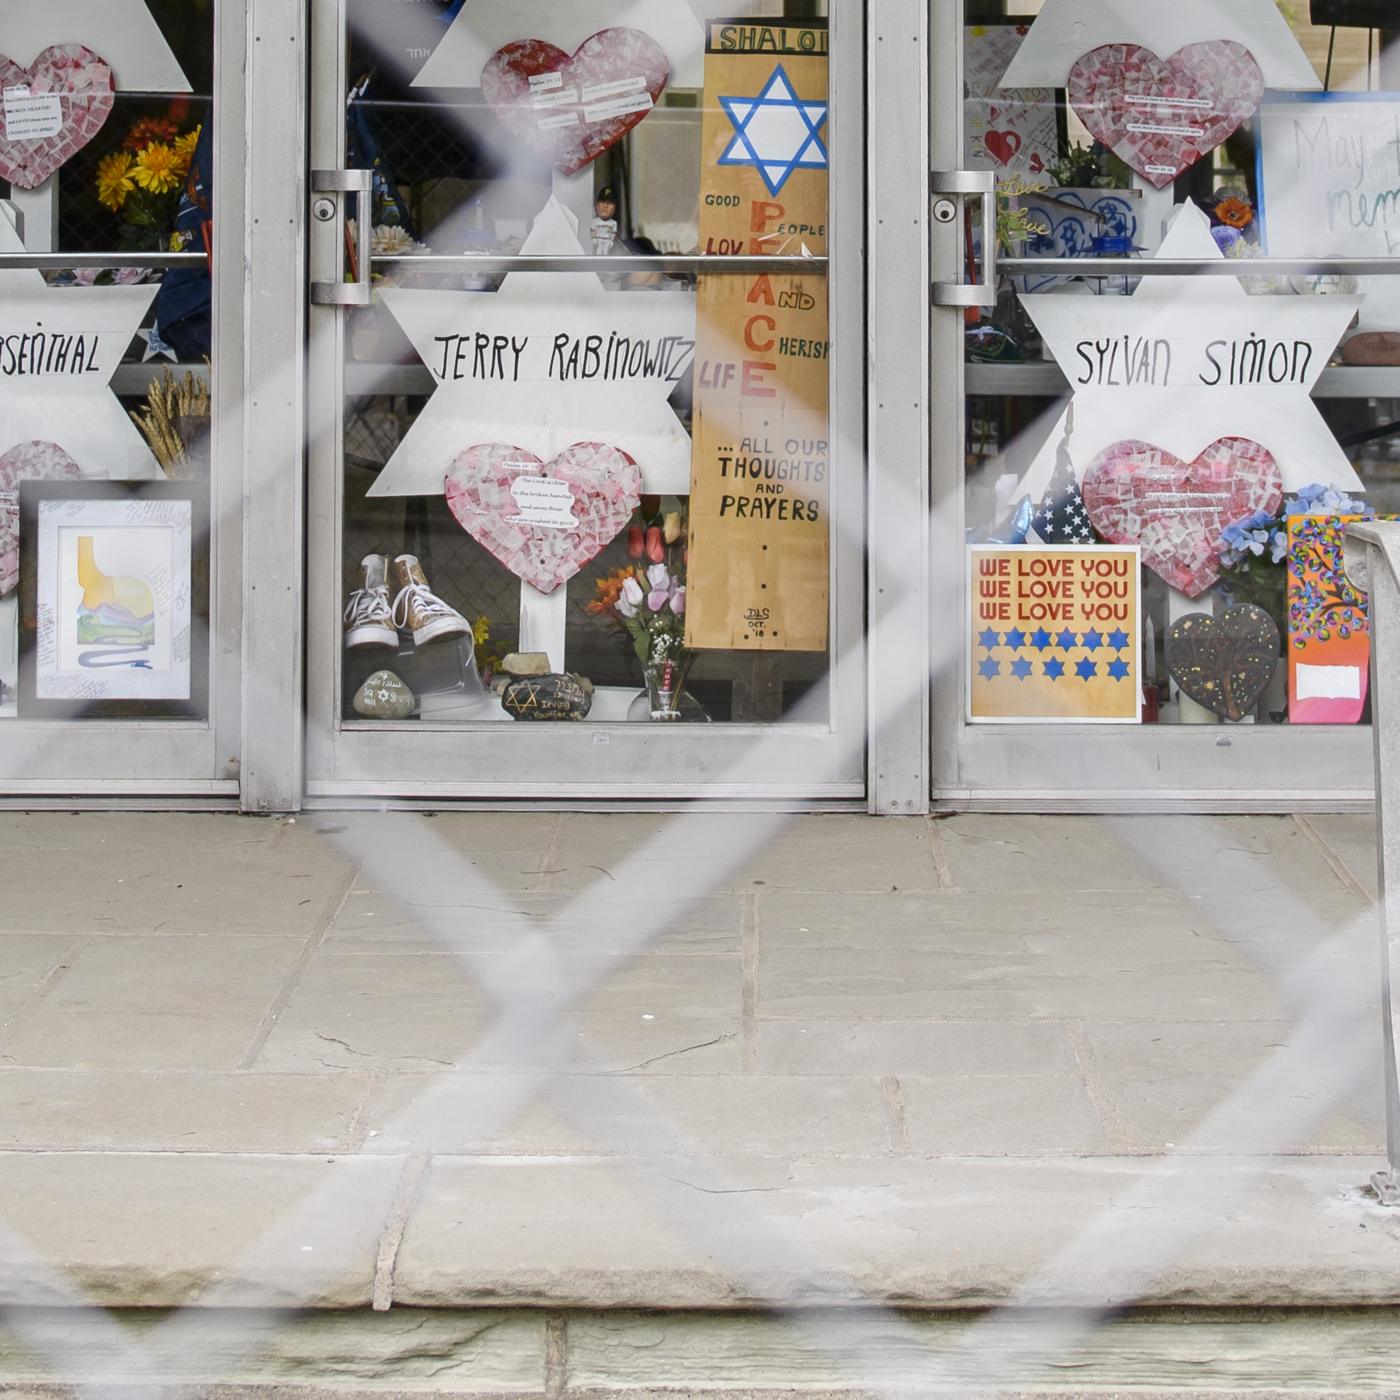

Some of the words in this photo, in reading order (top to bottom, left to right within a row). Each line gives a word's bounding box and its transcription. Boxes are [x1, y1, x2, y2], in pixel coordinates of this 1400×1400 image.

[434, 333, 528, 381] JERRY
[549, 332, 695, 381] RABINOWITZ
[1075, 337, 1171, 386] SYLVAN
[1199, 339, 1312, 385] SIMON
[740, 439, 775, 453] ALL
[786, 440, 828, 454] OUR
[719, 458, 825, 478] THOUGHTS
[757, 483, 784, 494] AND
[720, 495, 820, 521] PRAYERS
[979, 559, 1010, 577] WE
[1017, 559, 1074, 577] LOVE
[1081, 559, 1128, 577] YOU
[979, 580, 1010, 598] WE
[1017, 580, 1074, 598] LOVE
[1081, 580, 1128, 598] YOU
[979, 602, 1010, 621] WE
[1017, 602, 1074, 621] LOVE
[1081, 602, 1128, 621] YOU
